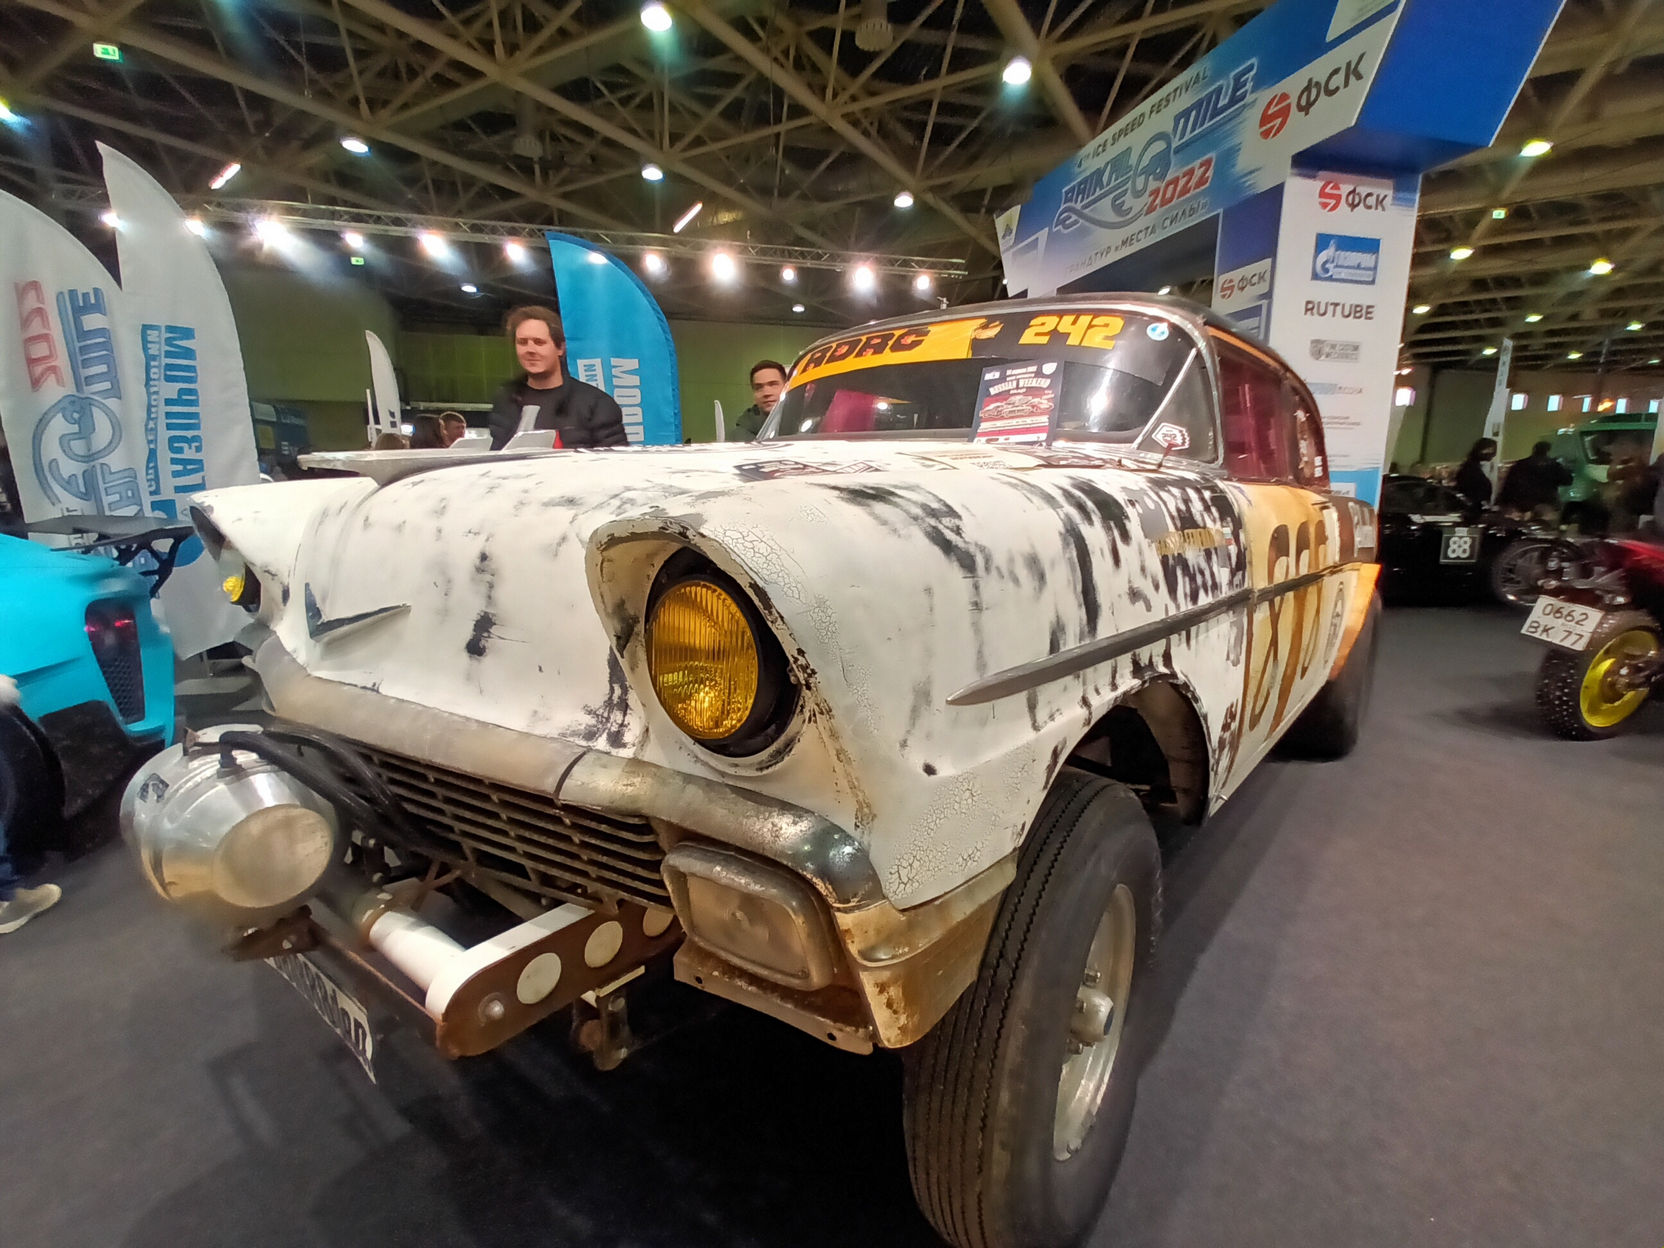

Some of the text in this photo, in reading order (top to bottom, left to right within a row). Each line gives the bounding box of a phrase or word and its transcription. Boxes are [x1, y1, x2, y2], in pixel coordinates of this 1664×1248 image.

[1172, 58, 1257, 142] MILE
[1296, 51, 1366, 117] ФСК
[1091, 138, 1107, 159] ICE
[1111, 113, 1145, 146] SPEED
[1148, 66, 1209, 121] FESTIVAL
[1144, 156, 1213, 216] 2022
[1345, 185, 1388, 213] ФСК
[1304, 300, 1375, 320] RUTUBE
[1018, 313, 1125, 350] 242
[1447, 536, 1471, 558] 88
[1542, 603, 1589, 627] 0662
[1559, 630, 1585, 646] 77
